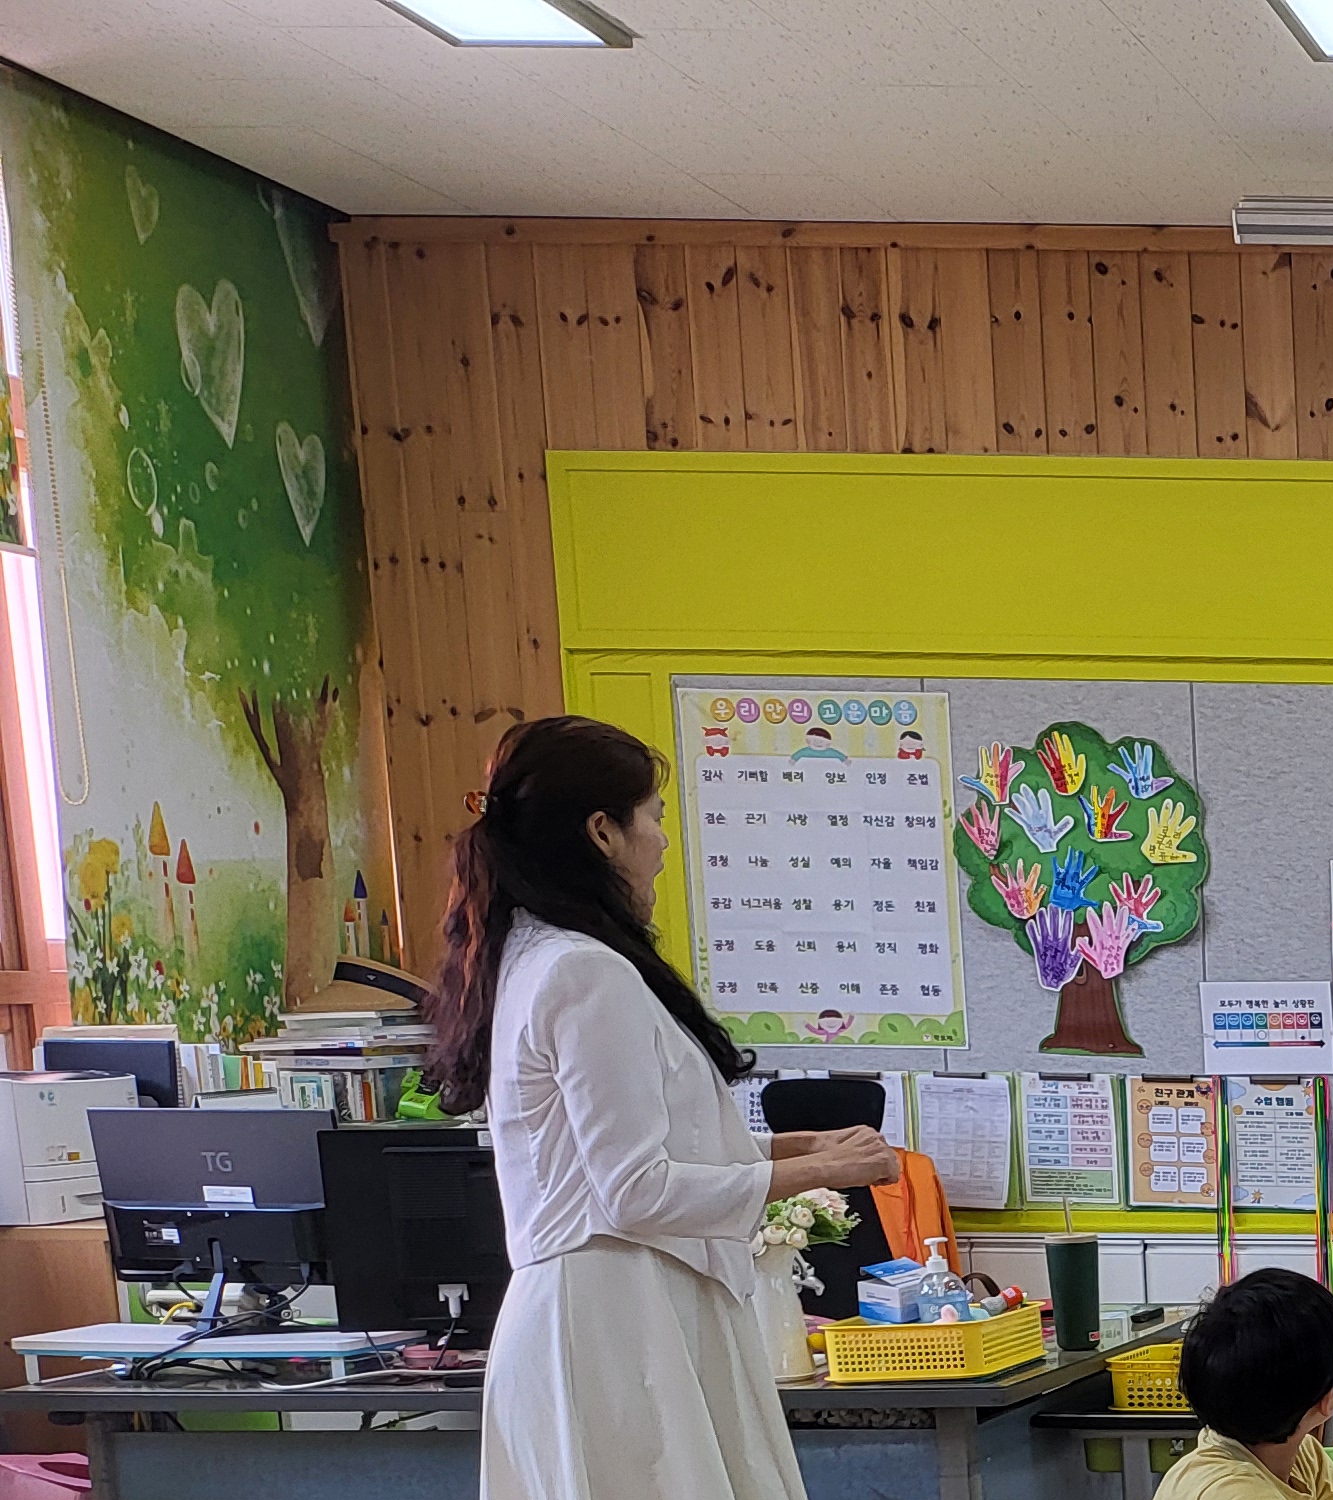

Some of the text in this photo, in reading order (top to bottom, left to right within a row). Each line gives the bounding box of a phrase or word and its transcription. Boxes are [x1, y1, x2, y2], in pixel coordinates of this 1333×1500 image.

[710, 697, 917, 725] 우리만의 고운마음
[702, 770, 723, 781] 감사
[782, 772, 803, 783] 배려
[825, 773, 847, 784] 양보
[866, 773, 887, 784] 인정
[907, 774, 928, 785] 준법
[705, 813, 936, 828] 겸손 끈기 사랑 열정 자신감 창의성
[708, 855, 939, 871] 경청 나눔 성실 예의 자율 책임감
[711, 899, 936, 912] 공감 너그러움 성찰 용기 정돈 친절
[754, 941, 939, 954] 도움 신뢰 용서 정직 평화
[757, 982, 778, 993] 만족
[799, 983, 819, 993] 신중
[840, 983, 861, 994] 이해
[879, 984, 899, 995] 존중
[920, 985, 941, 996] 협동
[1155, 1088, 1173, 1098] 친구
[200, 1152, 234, 1172] TG
